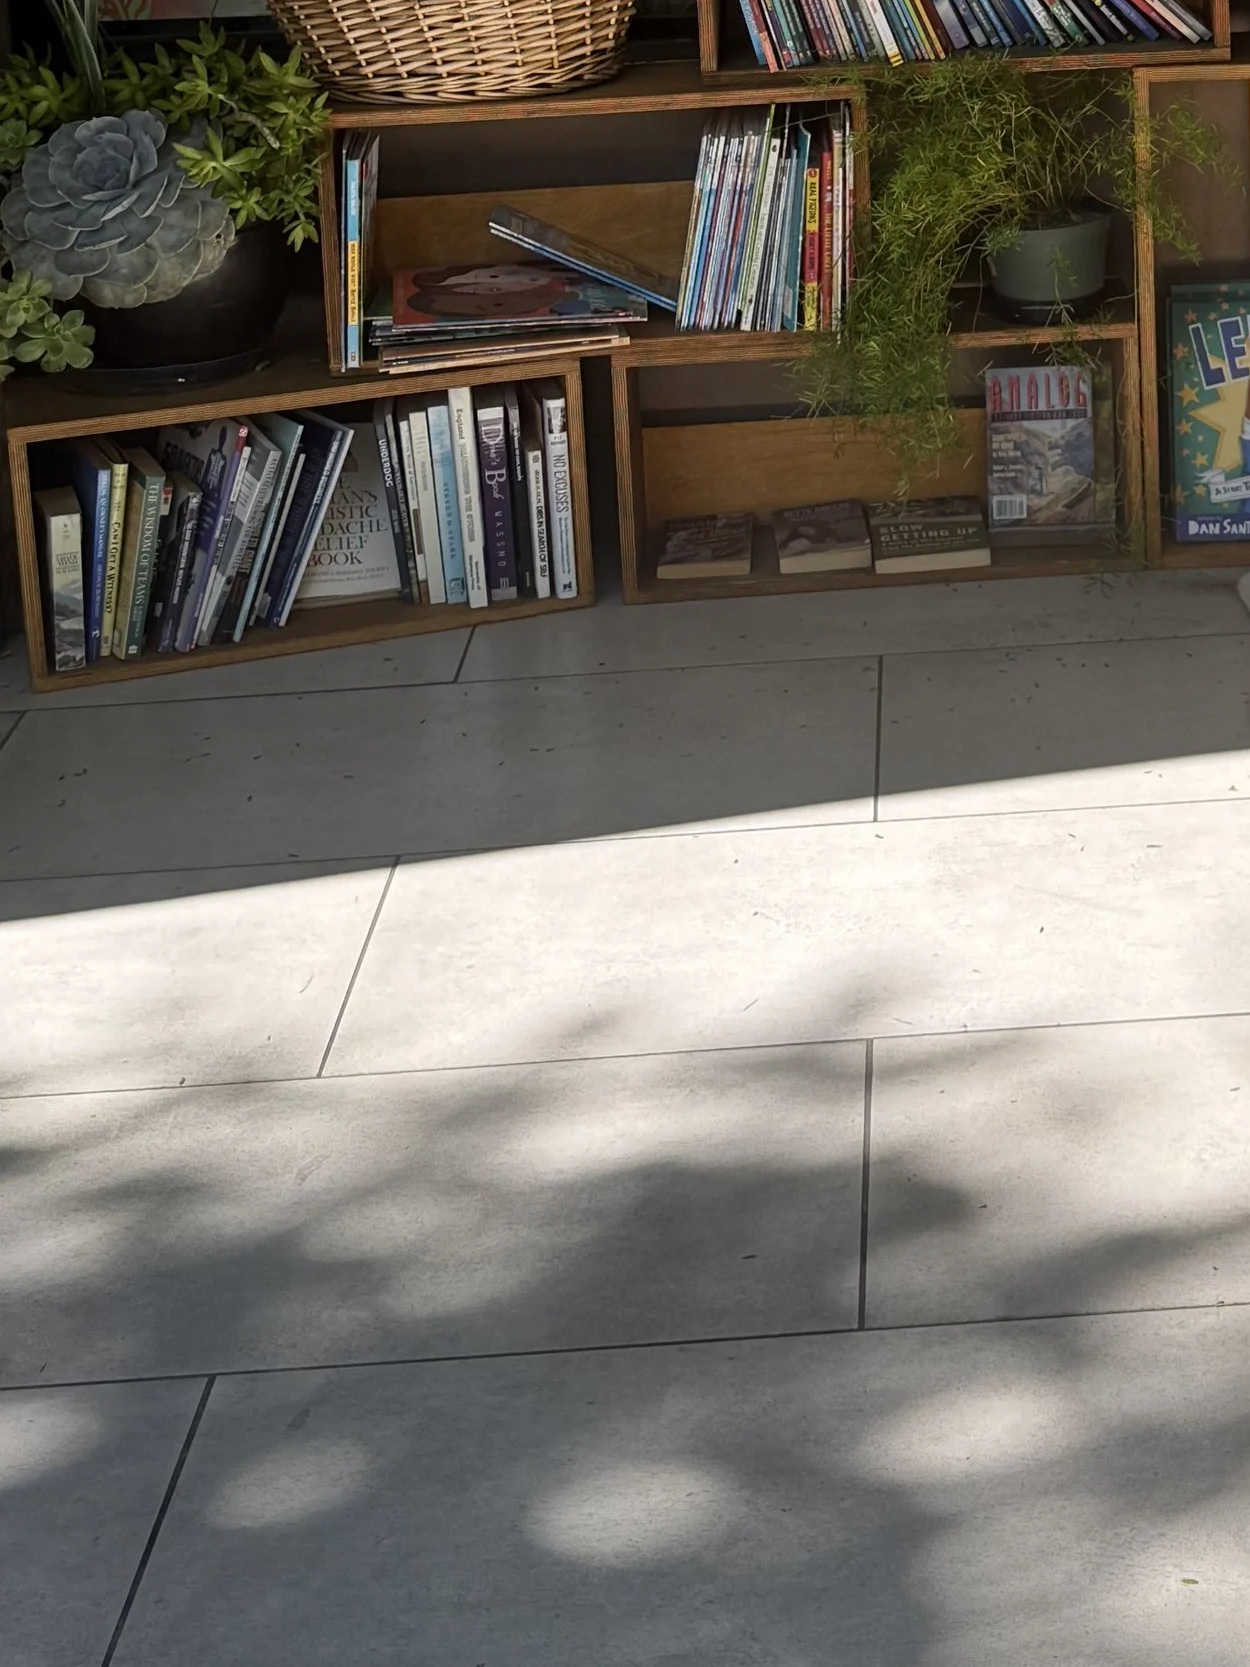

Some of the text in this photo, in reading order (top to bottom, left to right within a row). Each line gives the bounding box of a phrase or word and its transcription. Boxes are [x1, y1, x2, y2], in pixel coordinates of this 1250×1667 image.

[808, 198, 817, 224] PIGEONS
[990, 370, 1087, 412] ANALOG
[455, 408, 464, 440] England
[378, 439, 394, 487] UNDERDOG
[552, 453, 568, 514] NO EXCUSES
[1215, 488, 1221, 496] A
[878, 522, 924, 533] SLOW
[880, 526, 980, 542] GETTING UP
[1188, 520, 1220, 535] DAN
[134, 484, 160, 606] THE WISDOM OF TEAMS
[314, 536, 369, 551] ELIEF
[537, 529, 546, 553] SEARCH
[307, 551, 362, 567] BOOK
[538, 553, 546, 563] OF
[539, 564, 547, 578] SELF
